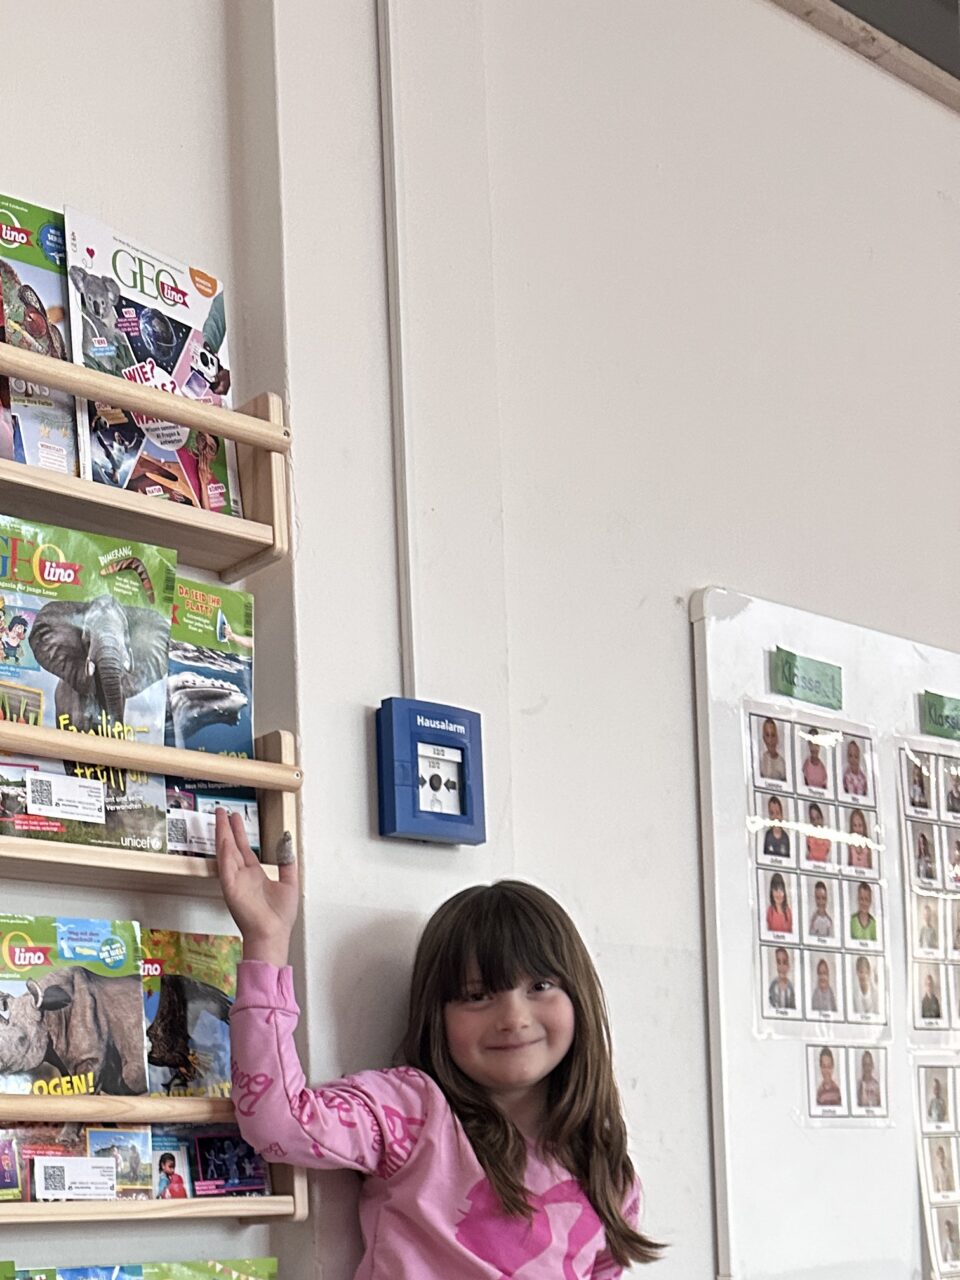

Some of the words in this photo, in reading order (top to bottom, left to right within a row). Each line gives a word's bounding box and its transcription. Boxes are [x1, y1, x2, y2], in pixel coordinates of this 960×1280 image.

[2, 226, 28, 244] lino
[112, 249, 179, 307] GEO
[162, 283, 184, 302] lino
[124, 360, 156, 384] WIE?
[44, 561, 75, 582] lino
[416, 715, 466, 735] Hausalarm
[121, 836, 150, 849] unicef
[14, 947, 45, 965] lino
